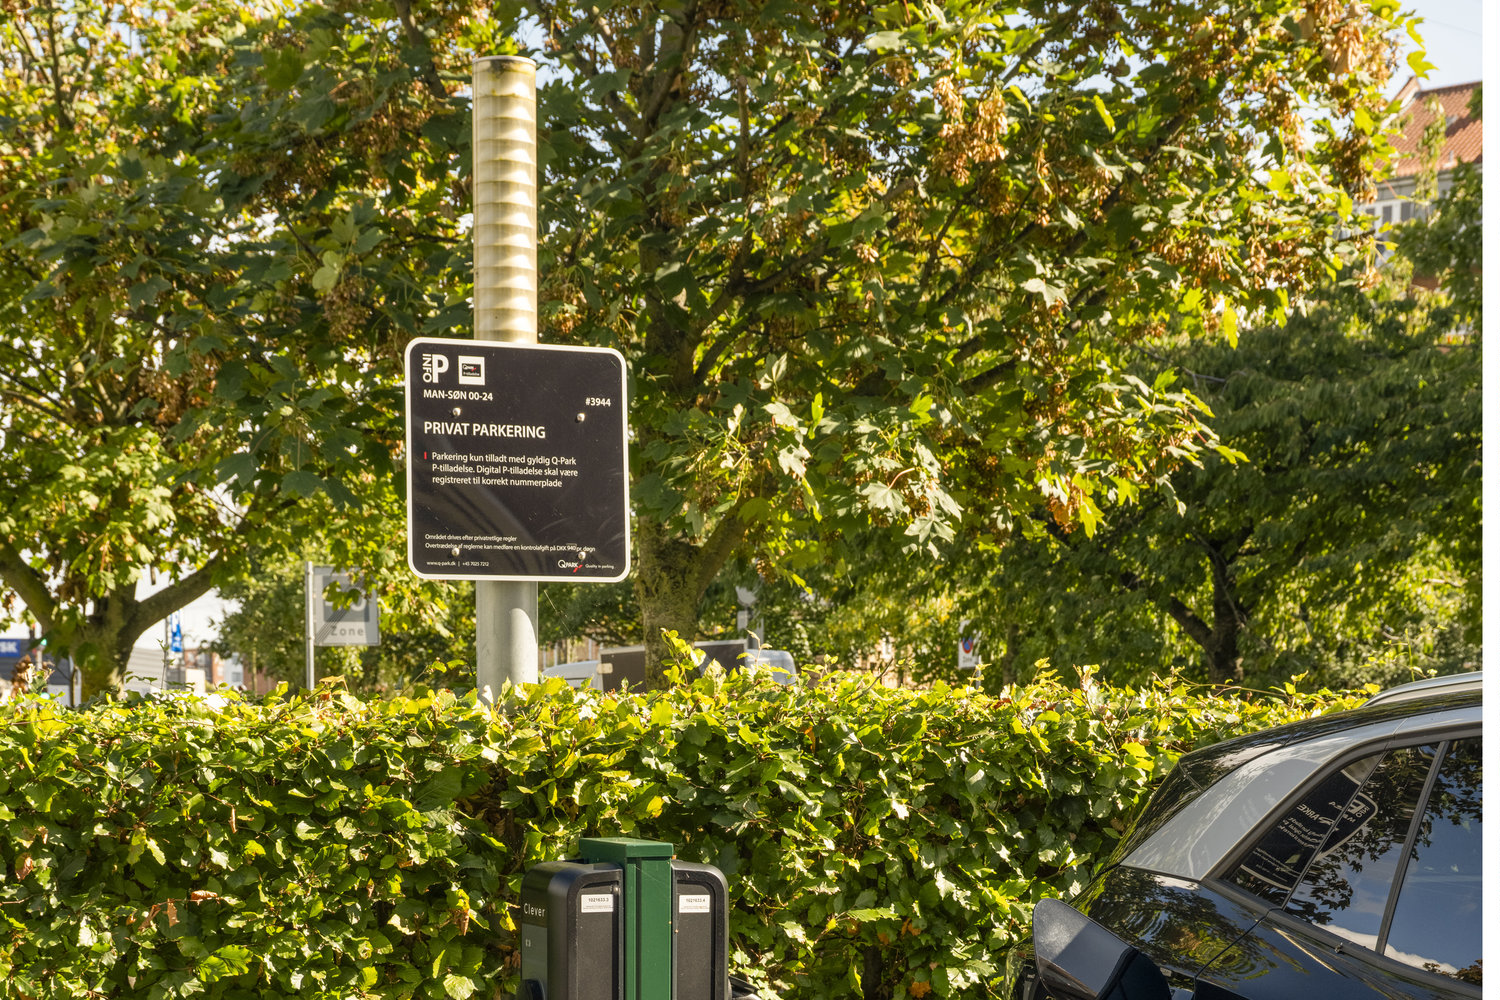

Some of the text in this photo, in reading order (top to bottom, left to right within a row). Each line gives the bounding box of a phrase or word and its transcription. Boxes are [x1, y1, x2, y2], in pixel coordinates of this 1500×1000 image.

[422, 353, 432, 383] INFO
[424, 389, 493, 401] MAN-SØN 00-24
[585, 397, 611, 407] #3944
[424, 421, 546, 439] PRIVAT PARKERING
[432, 452, 576, 466] Parkering kun tilladt med gyldig Q-Park
[432, 464, 475, 473] P-tilladelse.
[476, 465, 501, 475] Digital
[502, 466, 543, 475] P-tilladelse
[544, 468, 558, 476] skal
[432, 476, 471, 485] registreret
[482, 477, 508, 485] korrekt
[510, 478, 562, 488] nummerplade
[331, 626, 364, 636] Zone
[523, 903, 546, 917] Clever
